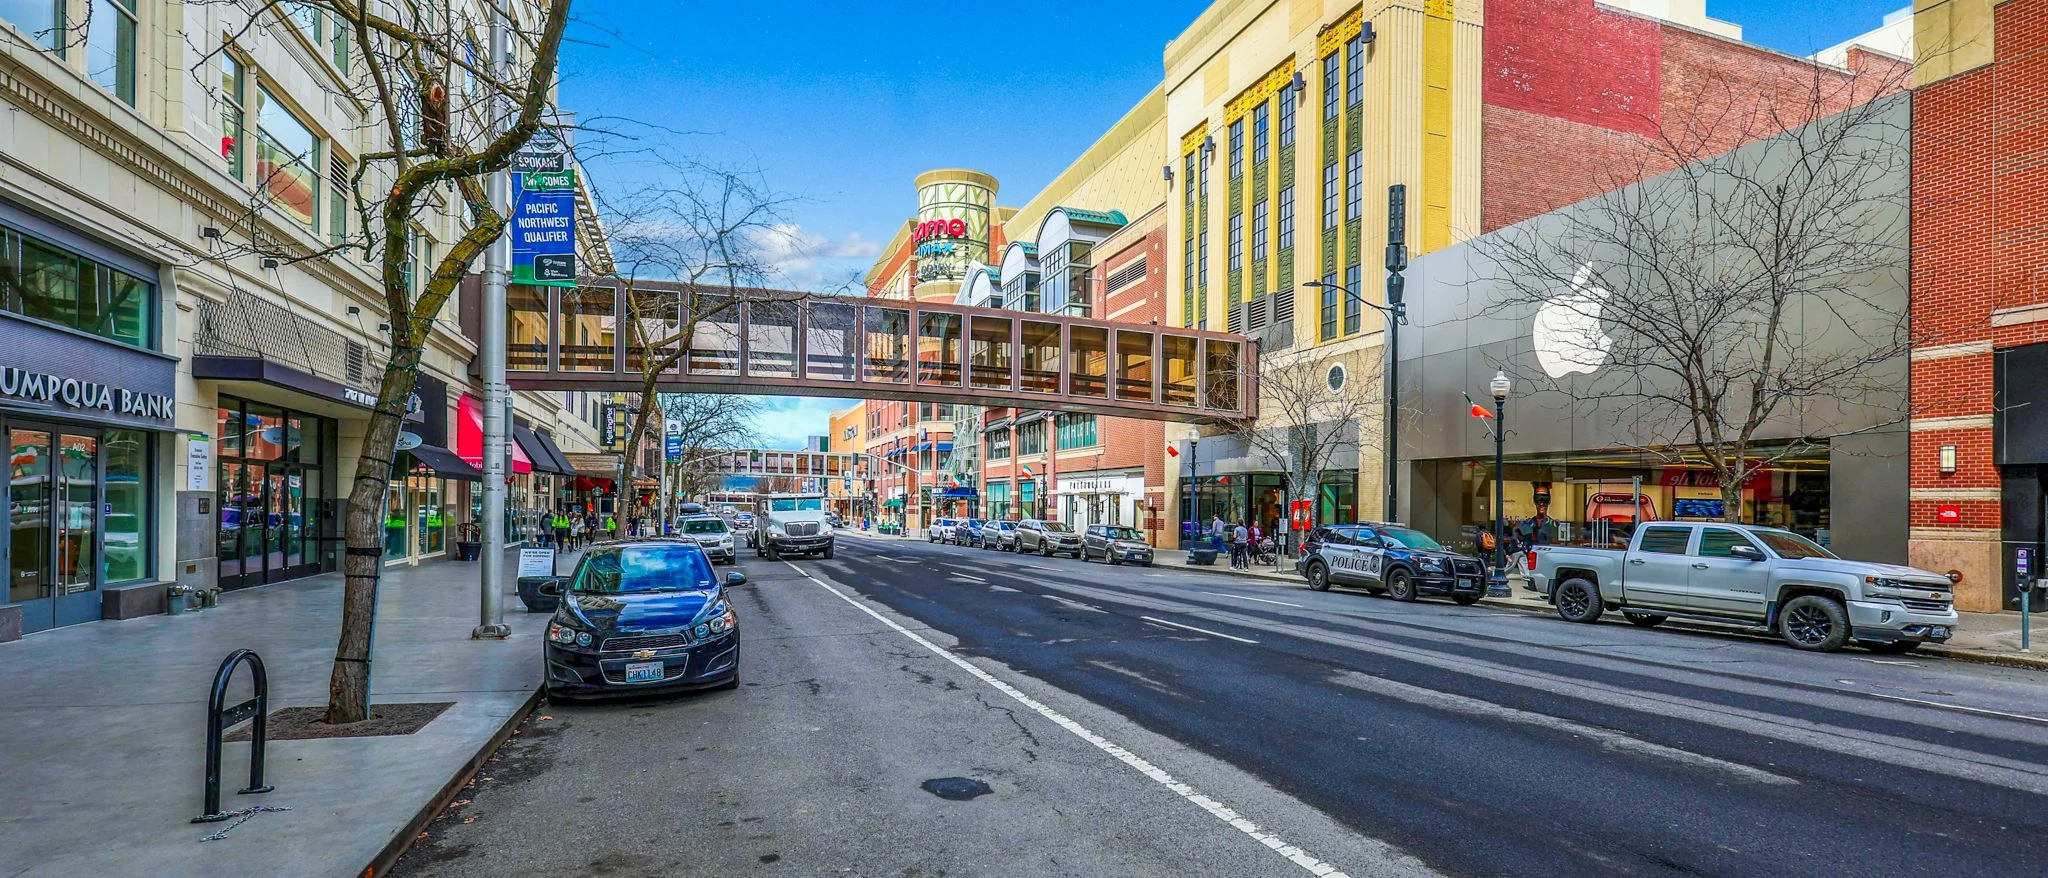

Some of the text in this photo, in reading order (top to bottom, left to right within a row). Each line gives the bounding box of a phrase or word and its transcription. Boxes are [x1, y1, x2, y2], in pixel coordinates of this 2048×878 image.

[518, 156, 559, 168] SPOKANE
[526, 176, 569, 186] WECOMES
[525, 203, 558, 214] PACIFIC
[518, 217, 569, 228] NORTHWEST
[524, 231, 568, 243] QUALIFIER
[917, 242, 955, 256] IMAX
[0, 366, 174, 420] UMPQUA BANK
[72, 443, 86, 452] A02
[1331, 555, 1369, 572] POLICE
